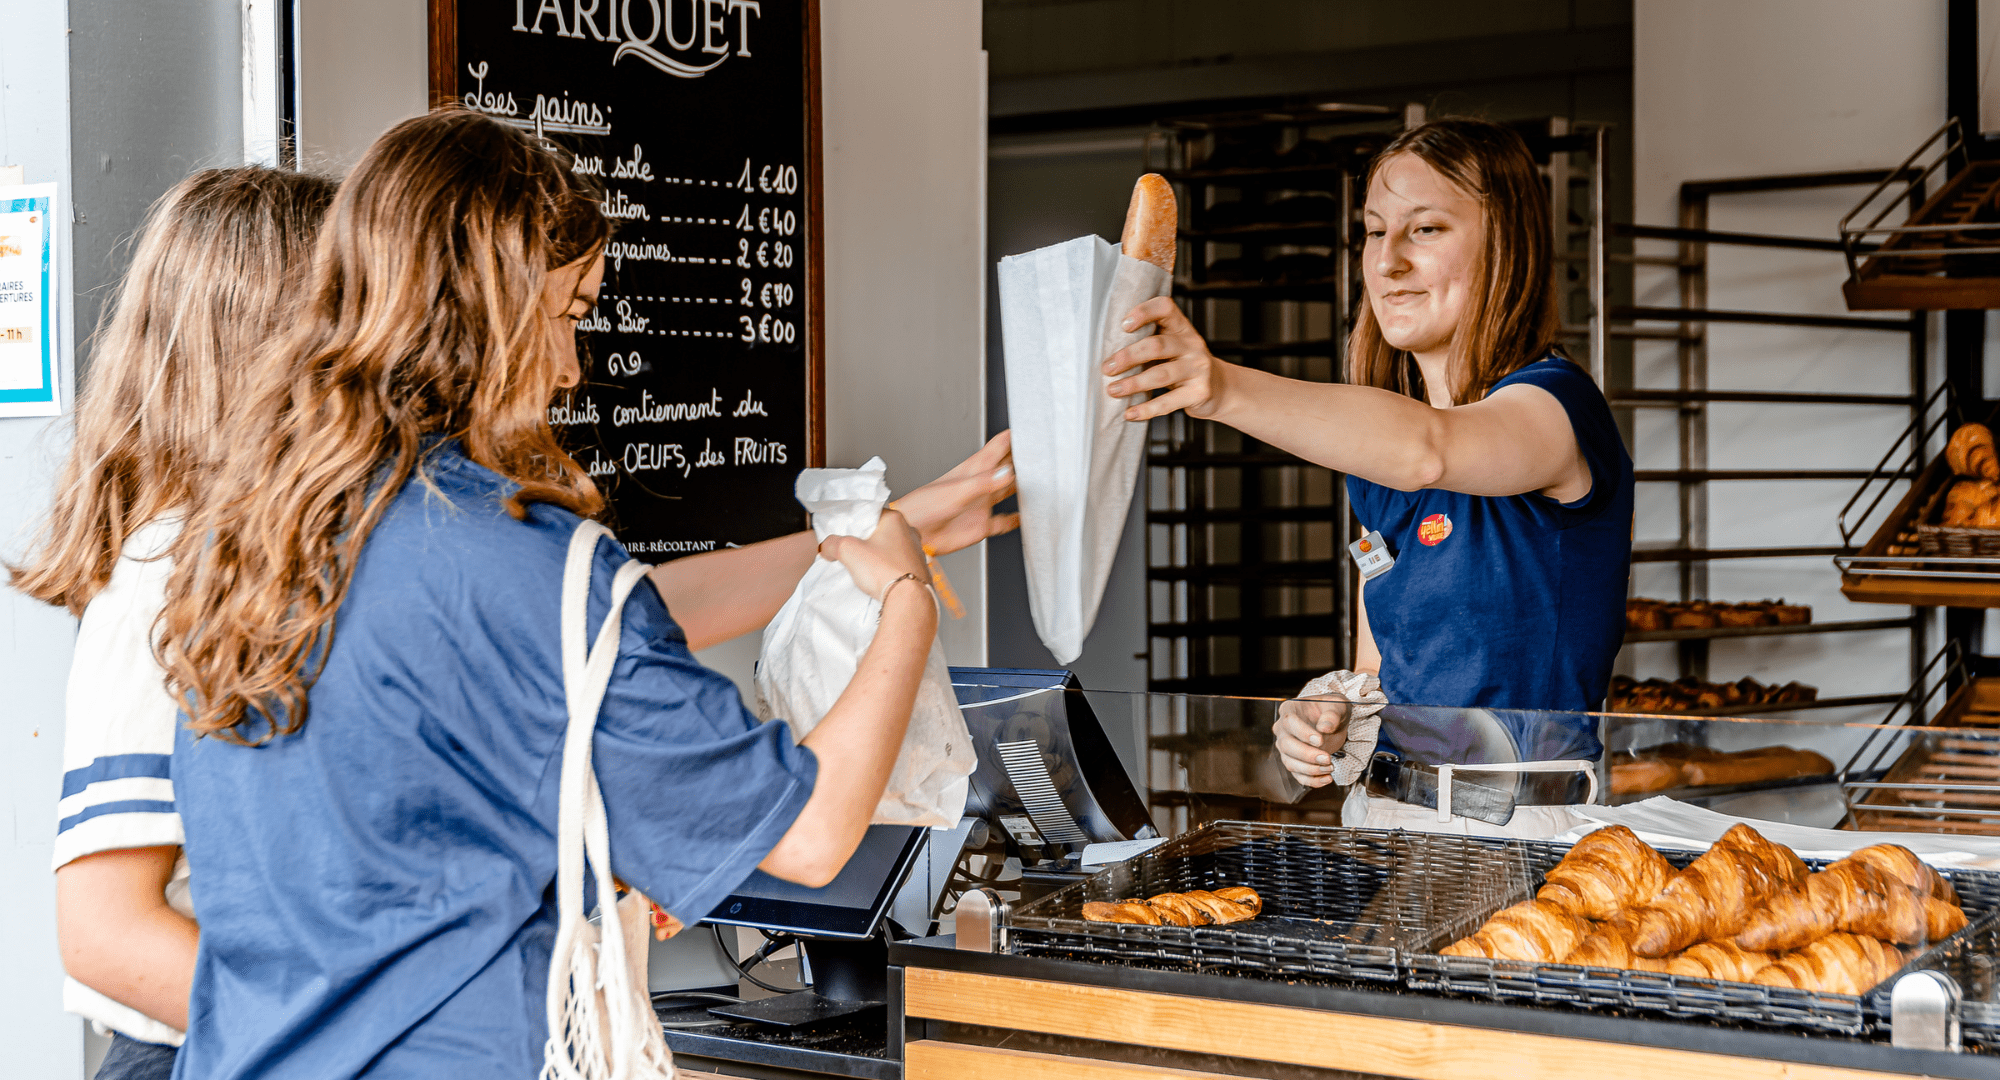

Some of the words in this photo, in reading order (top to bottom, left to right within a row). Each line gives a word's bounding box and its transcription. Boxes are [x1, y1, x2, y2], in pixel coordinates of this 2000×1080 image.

[464, 61, 518, 116] Les
[571, 153, 607, 177] sur
[611, 143, 655, 182] sole
[616, 300, 650, 333] Bio
[613, 387, 723, 427] contiennent
[733, 389, 769, 418] du
[586, 449, 616, 477] des
[695, 437, 726, 468] des
